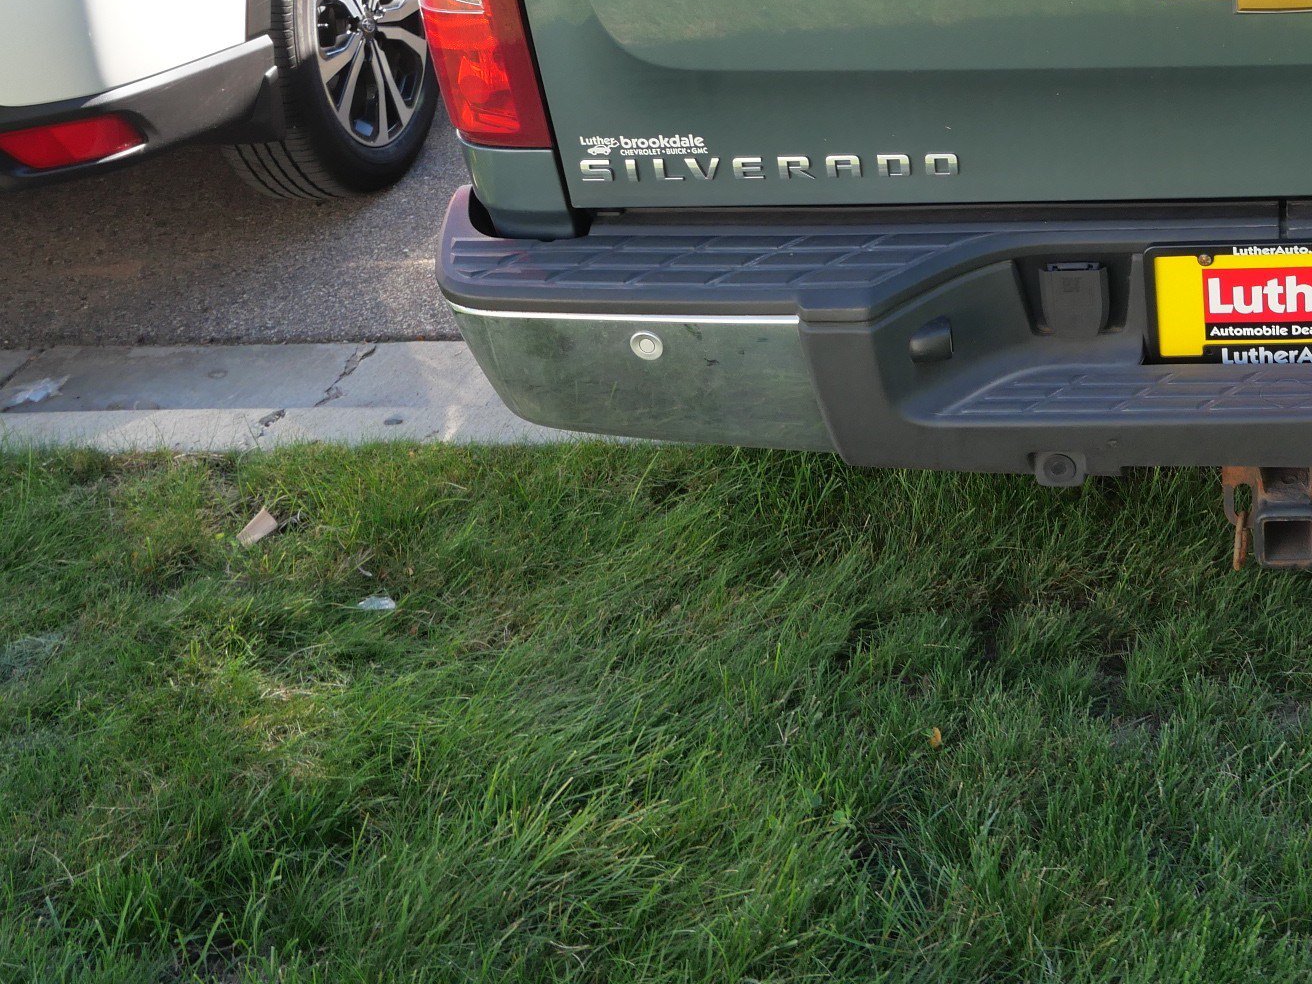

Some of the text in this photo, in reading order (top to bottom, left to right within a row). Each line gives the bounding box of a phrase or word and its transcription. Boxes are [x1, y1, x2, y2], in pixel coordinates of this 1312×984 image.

[579, 134, 704, 148] Luther brookdale
[579, 153, 959, 183] SILVERADO
[1210, 324, 1289, 337] Automobile
